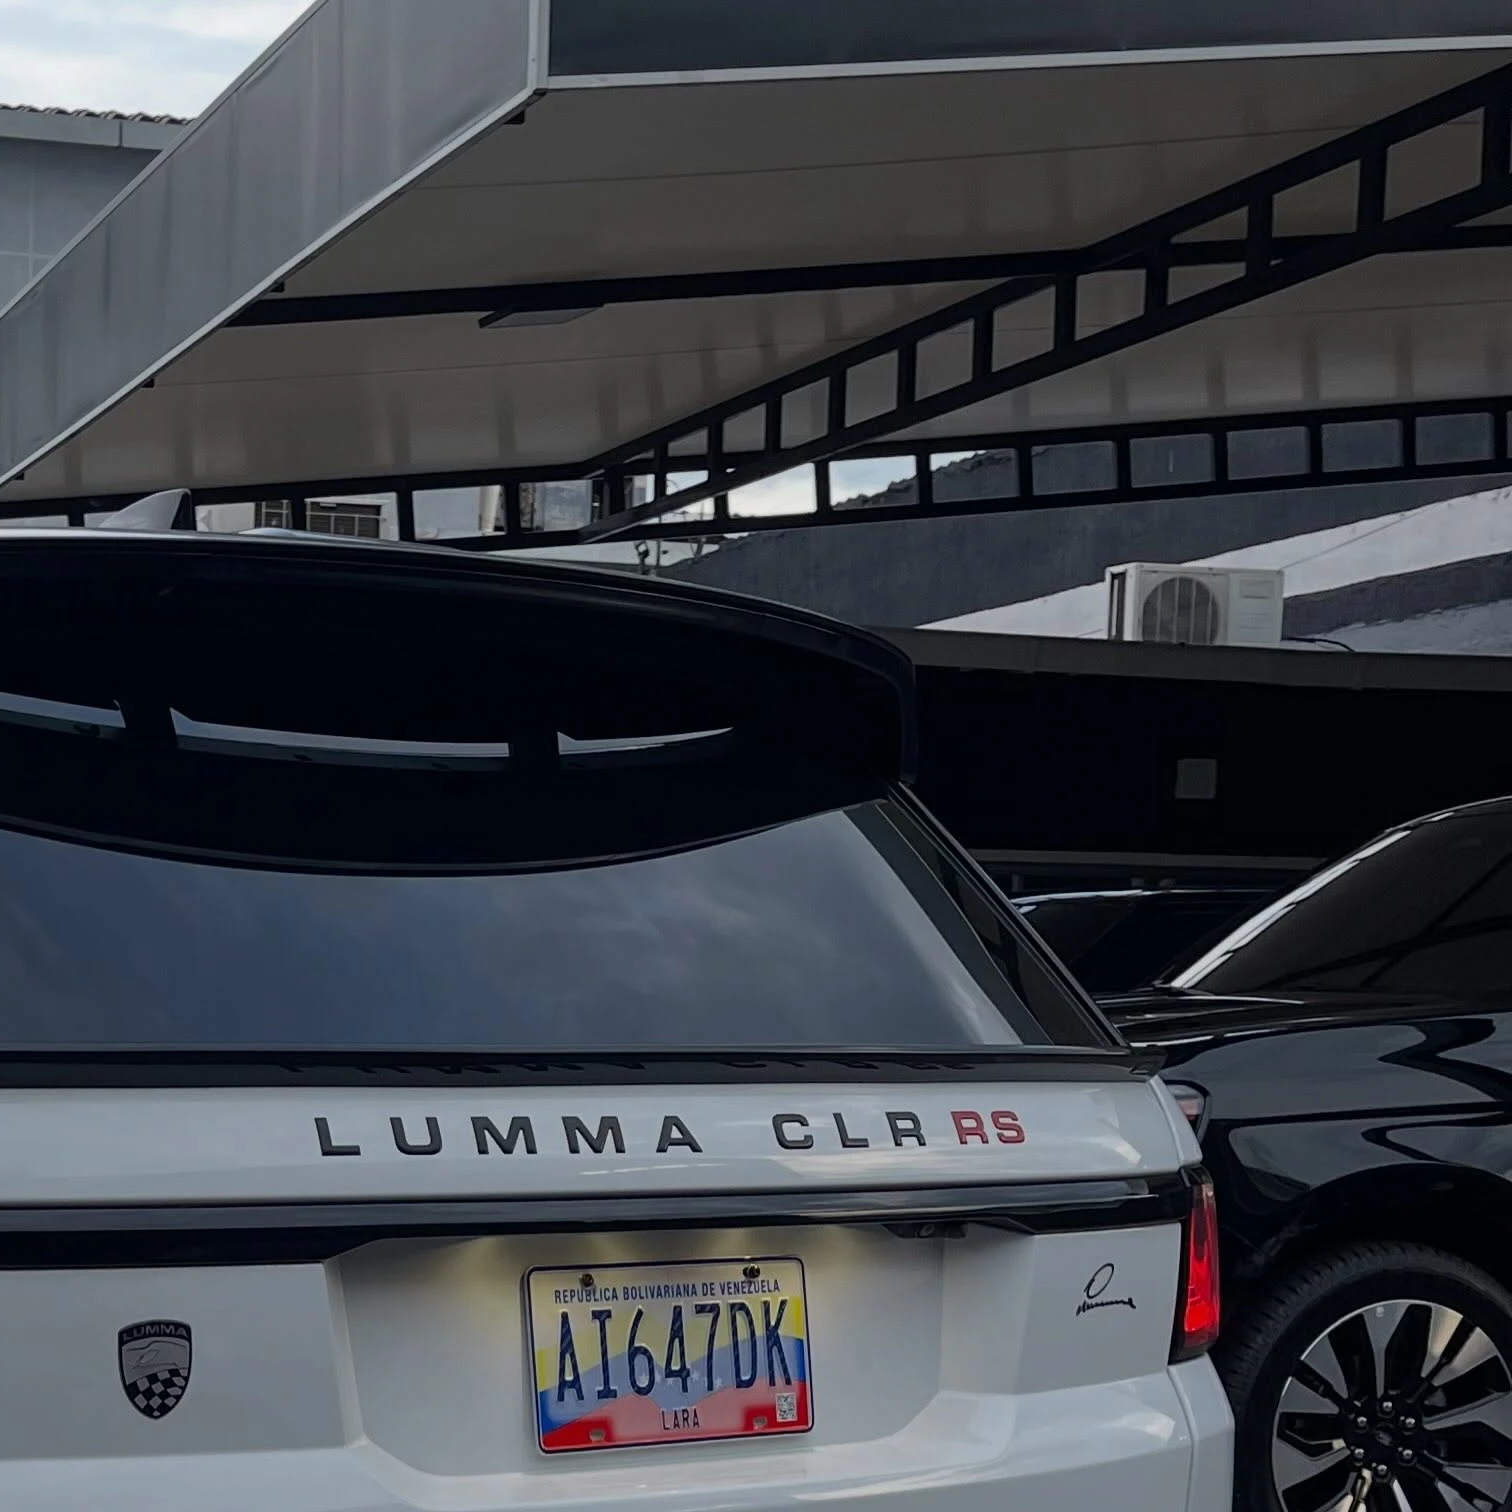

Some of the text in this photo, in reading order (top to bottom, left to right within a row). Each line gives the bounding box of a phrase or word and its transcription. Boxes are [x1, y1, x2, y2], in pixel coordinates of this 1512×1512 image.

[314, 1109, 1027, 1157] LUMMA CLR RS
[623, 1282, 697, 1301] BOLIVARIANA
[702, 1282, 716, 1297] DE
[718, 1279, 781, 1296] VENEZUELA
[122, 1324, 189, 1341] LUMMA
[557, 1299, 793, 1402] AI647DK
[661, 1407, 701, 1431] LARA
